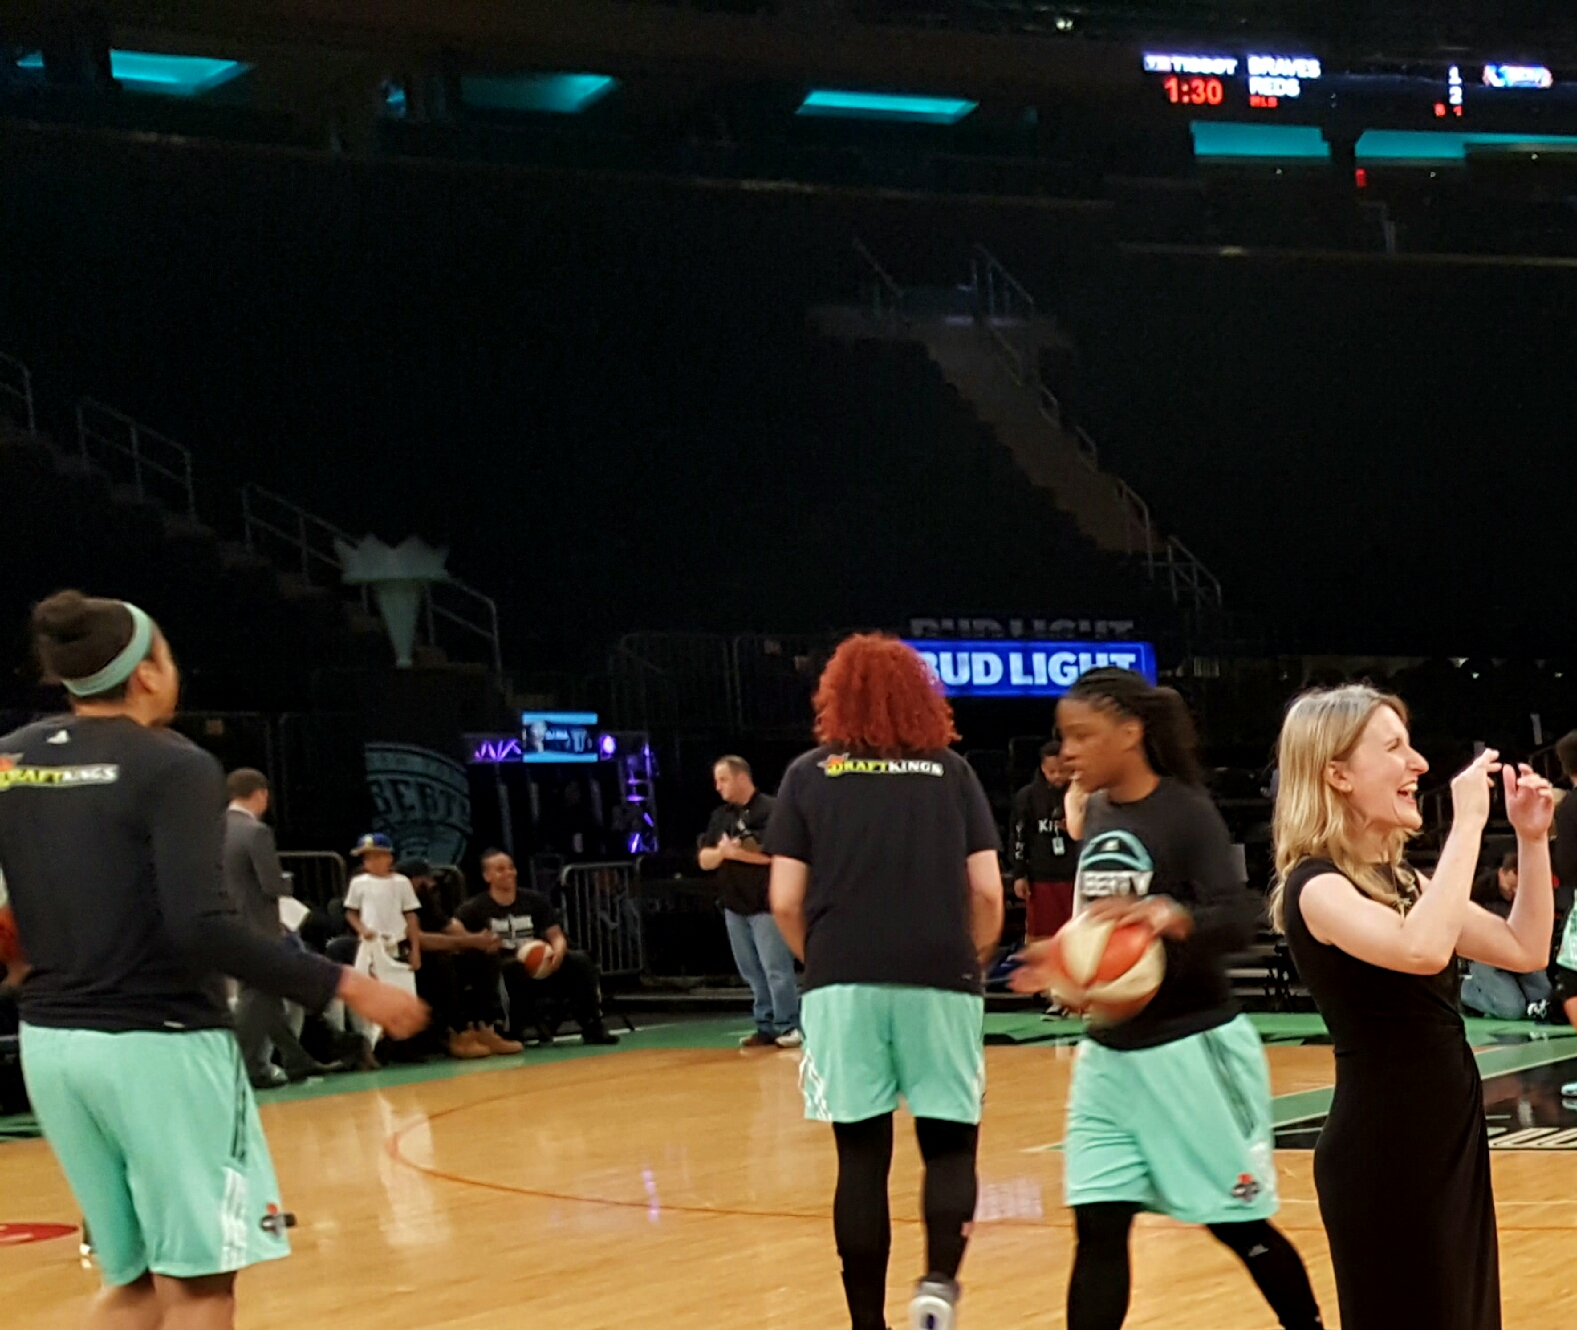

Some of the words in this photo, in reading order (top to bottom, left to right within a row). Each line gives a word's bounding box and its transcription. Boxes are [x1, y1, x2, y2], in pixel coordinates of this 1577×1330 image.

[1164, 78, 1224, 105] 1:30
[920, 652, 1004, 686] BUD
[825, 759, 944, 777] DRAFTKINGS
